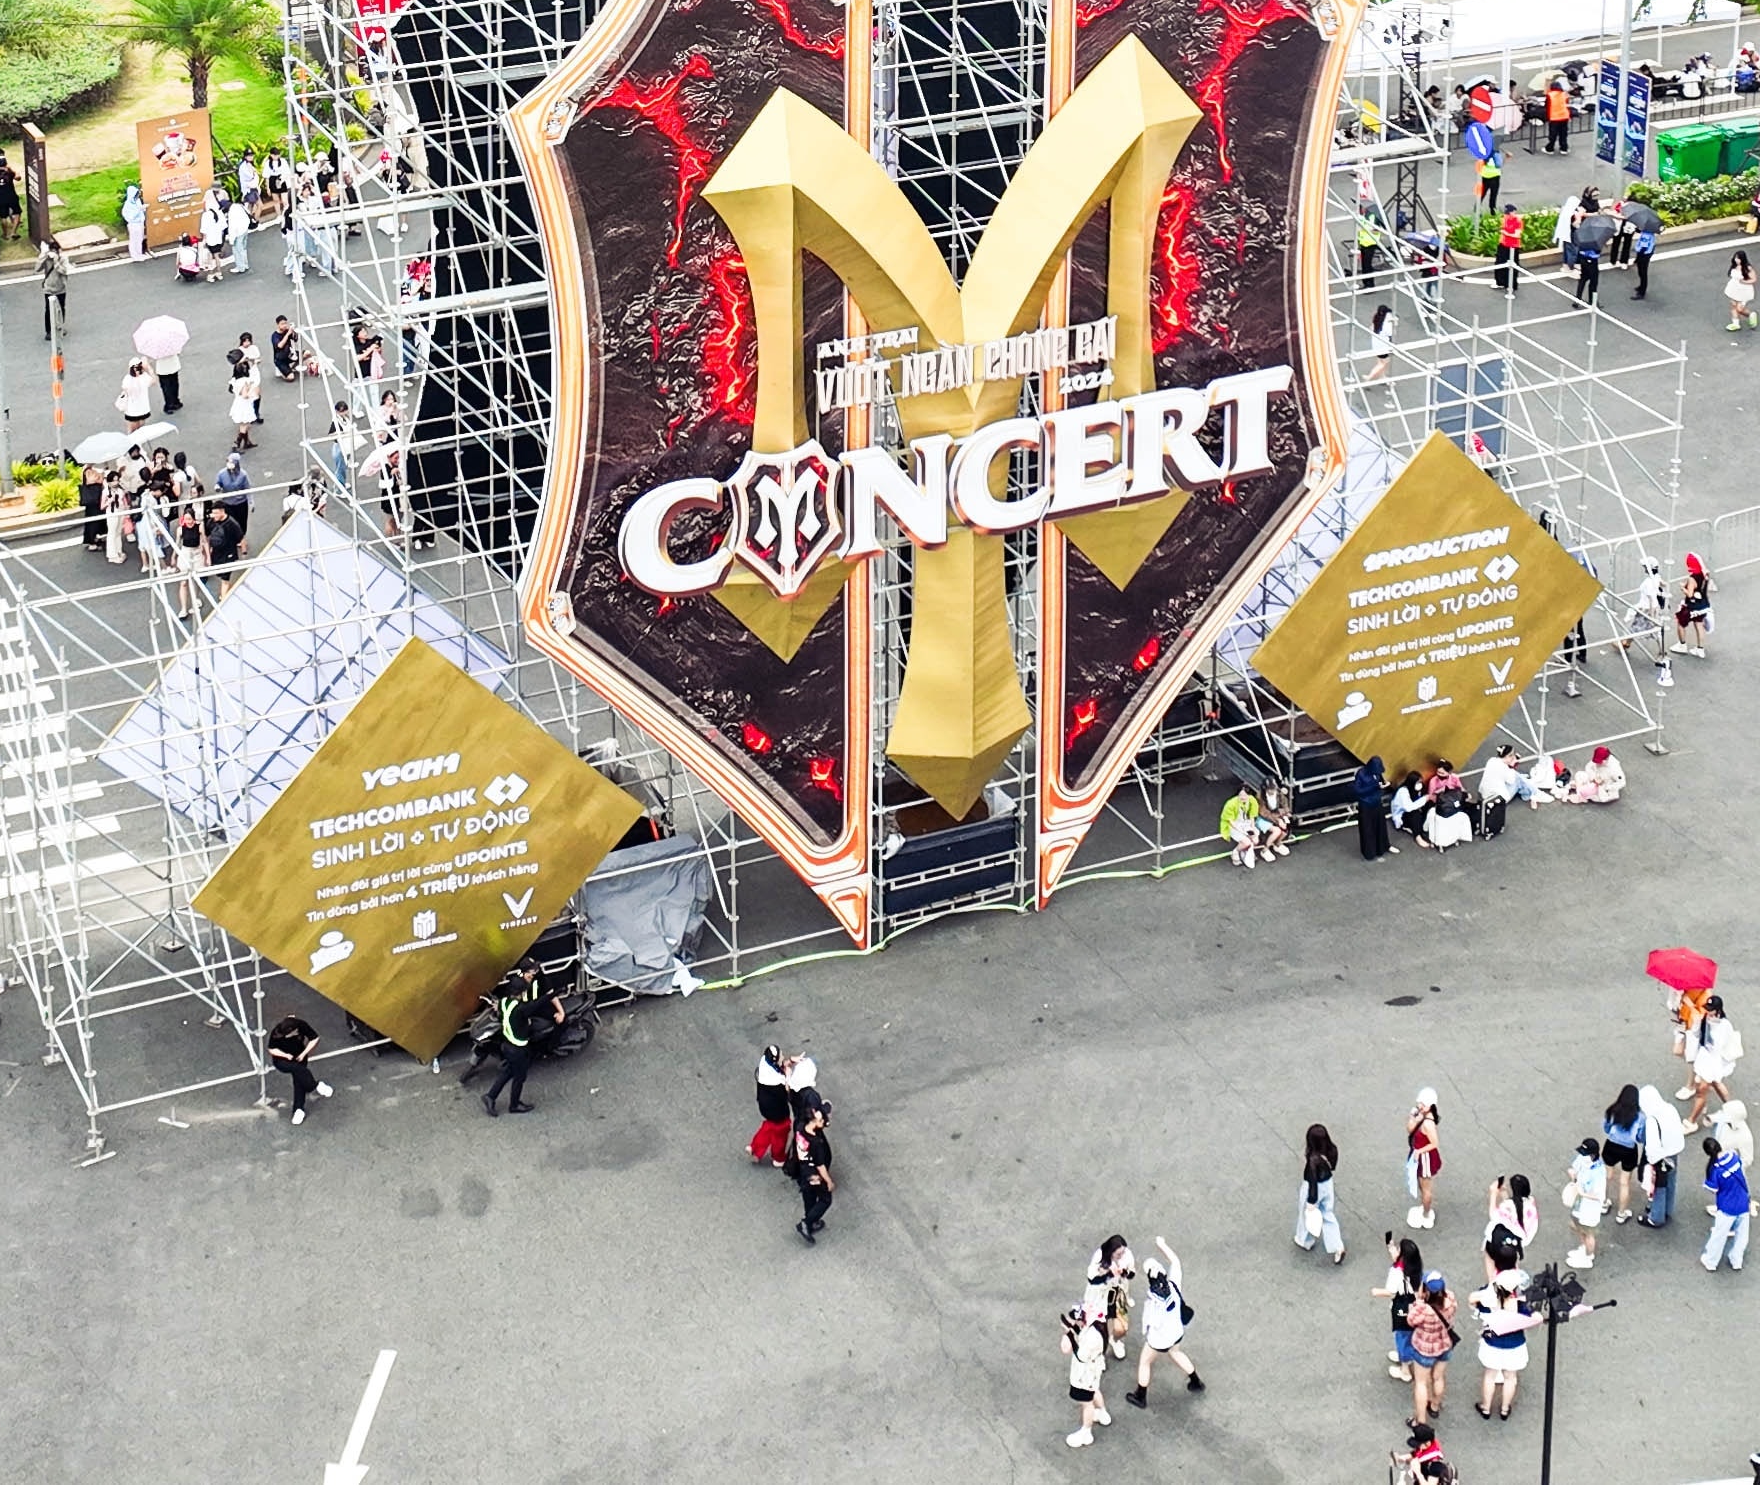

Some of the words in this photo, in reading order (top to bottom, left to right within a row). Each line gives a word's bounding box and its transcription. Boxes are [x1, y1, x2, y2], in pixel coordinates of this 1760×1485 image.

[817, 338, 866, 360] ANH
[873, 327, 919, 350] TRAI
[902, 340, 974, 399] NGÀN
[983, 327, 1068, 382] CHÔNG
[1076, 314, 1118, 365] GAI
[1059, 368, 1115, 394] 2024
[1363, 526, 1510, 573] 1PRODUCTION
[1348, 567, 1479, 609] TECHCOMBANK
[1347, 612, 1389, 635] SINH
[1392, 603, 1421, 626] LỜI
[1440, 593, 1465, 615] TỰ
[1456, 616, 1514, 639] UPOINTS
[1339, 672, 1354, 683] Tin
[1416, 653, 1428, 666] 4
[1428, 643, 1468, 665] TRIỆU
[309, 787, 477, 840] TECHCOMBANK
[312, 841, 364, 869] SINH
[370, 832, 405, 857] LỜI
[430, 818, 461, 843] TỰ
[464, 806, 530, 835] ĐỘNG
[317, 884, 349, 900] Nhân
[454, 840, 528, 868] UPOINTS
[306, 910, 326, 923] Tin
[326, 904, 358, 920] dùng
[405, 887, 419, 900] 4
[420, 873, 470, 897] TRIỆU
[508, 863, 539, 878] hàng
